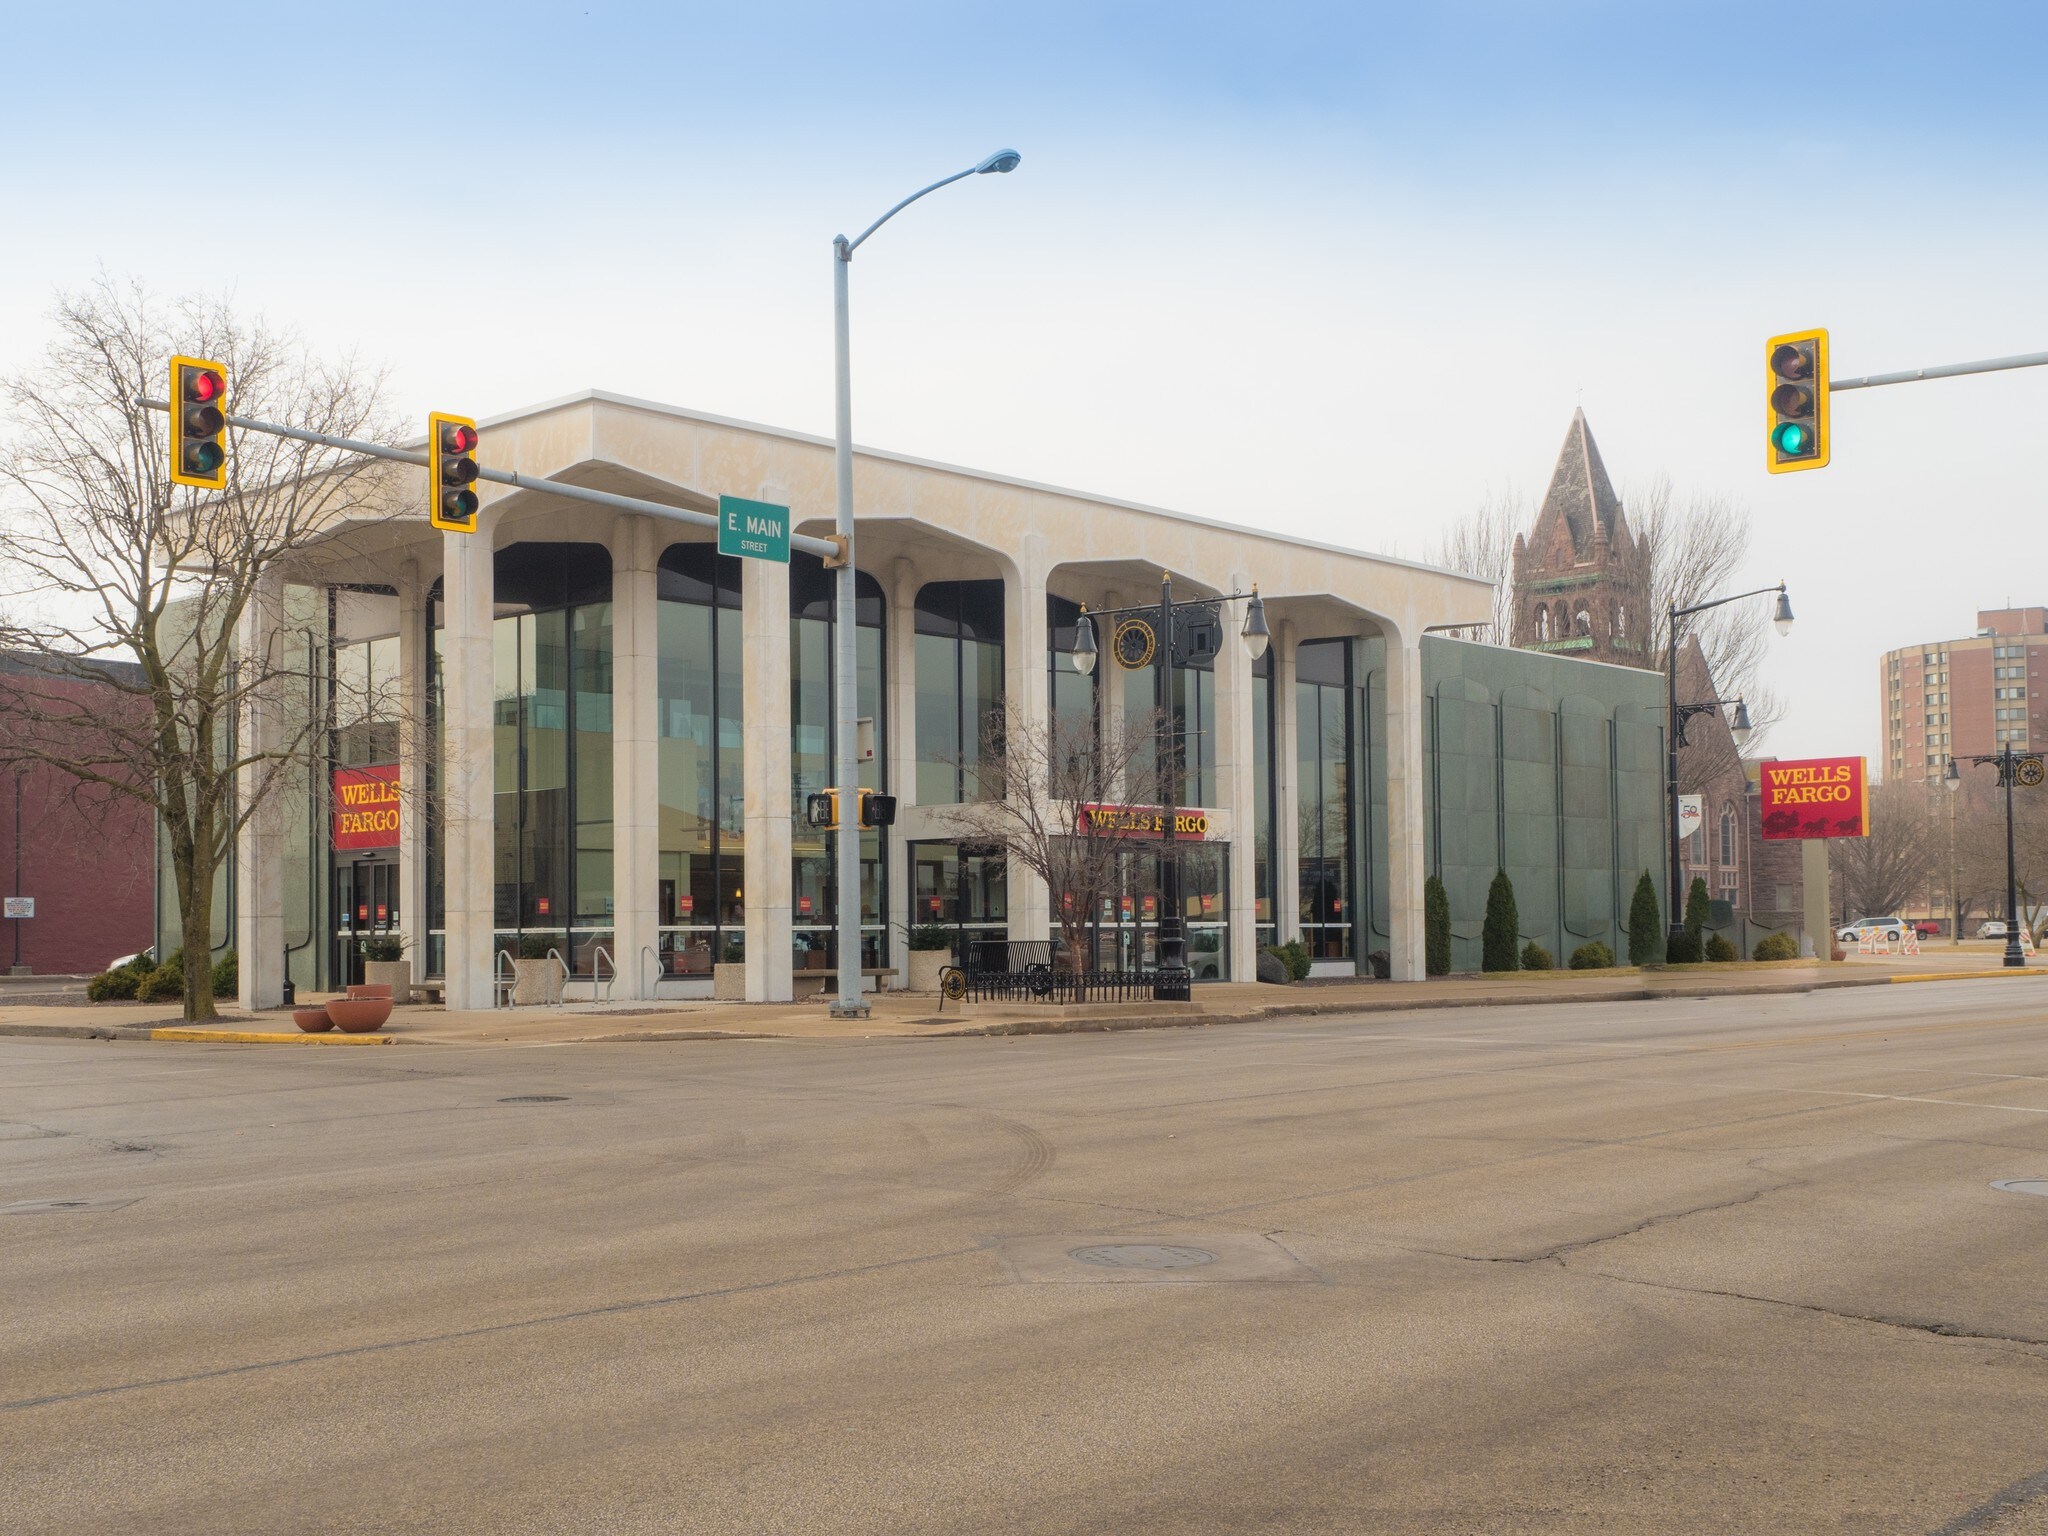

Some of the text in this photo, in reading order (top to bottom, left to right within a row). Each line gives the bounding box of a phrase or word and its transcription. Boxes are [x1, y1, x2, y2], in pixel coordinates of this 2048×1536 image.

[728, 512, 781, 538] E. MAIN
[741, 540, 768, 553] STREET
[1768, 765, 1852, 786] WELLS
[341, 780, 400, 805] WELLS
[1771, 785, 1852, 805] FARGO
[341, 809, 399, 834] FARGO
[1153, 815, 1208, 833] FRGO
